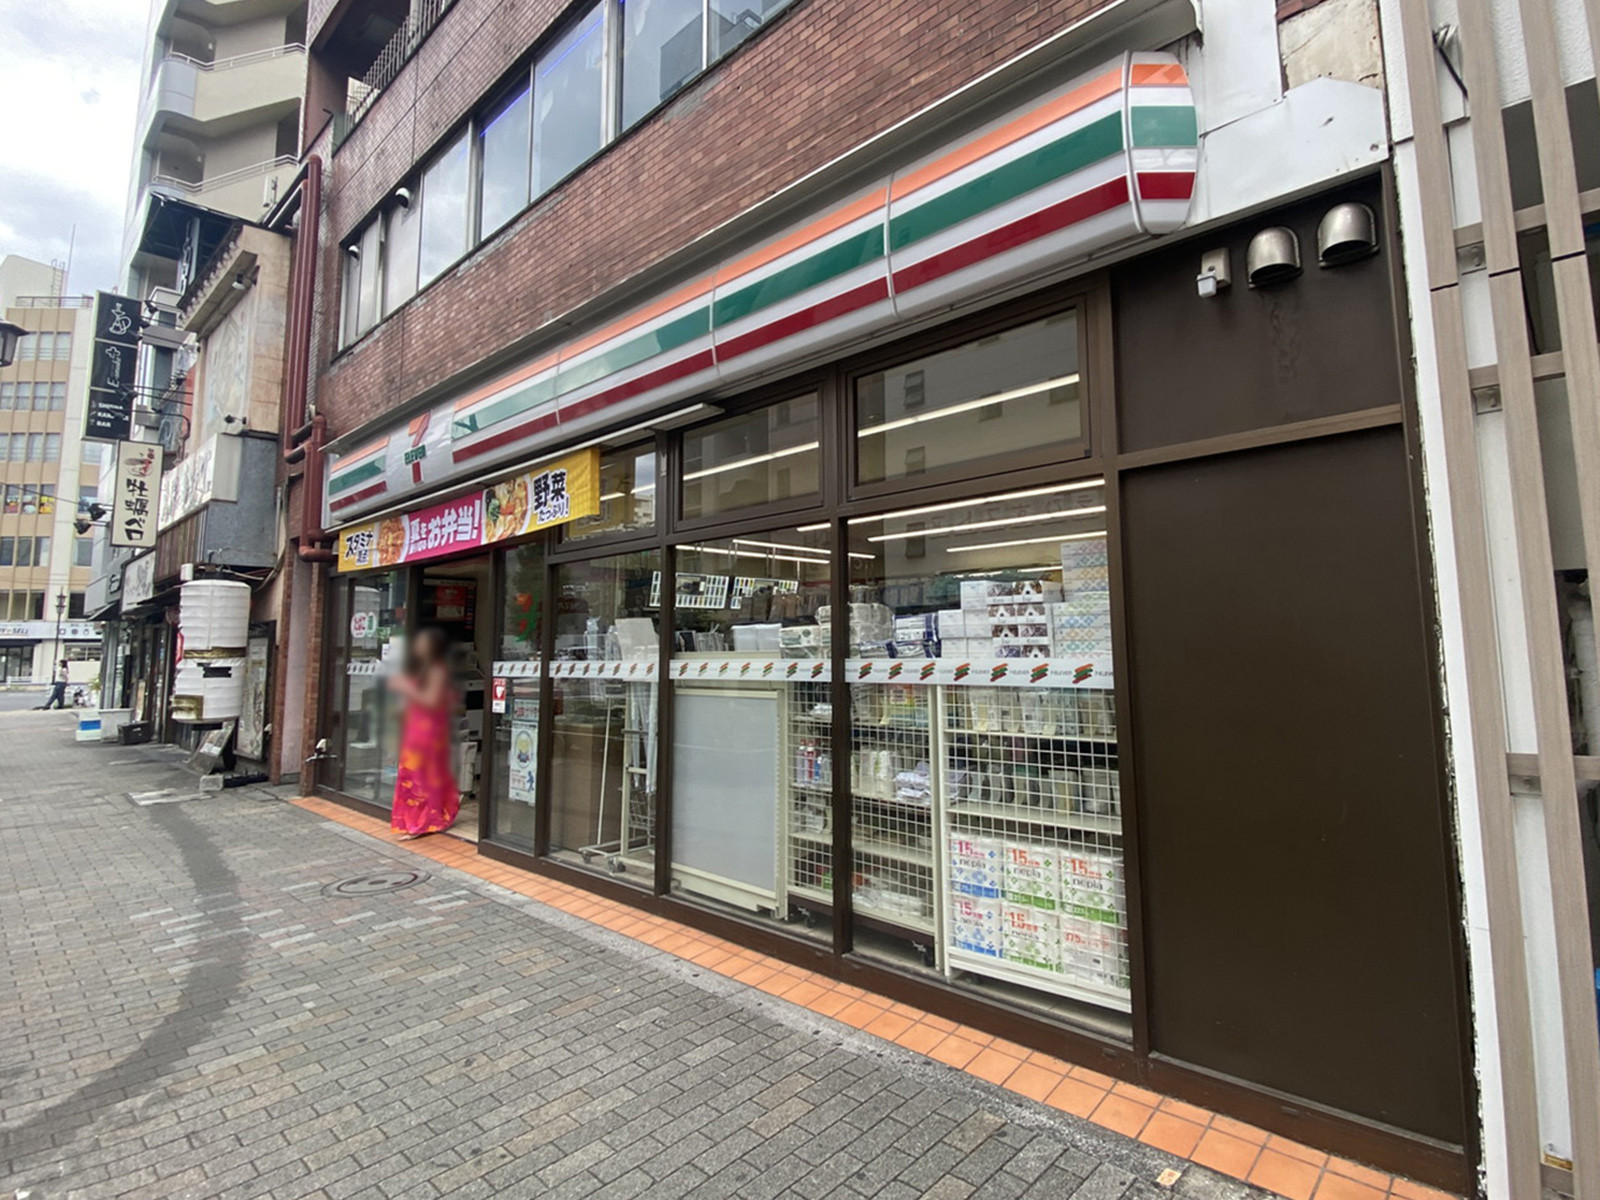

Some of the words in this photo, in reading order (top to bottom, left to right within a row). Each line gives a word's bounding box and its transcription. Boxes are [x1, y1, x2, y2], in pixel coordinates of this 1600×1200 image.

[96, 420, 112, 428] BAR
[534, 470, 566, 511] 野菜
[427, 498, 481, 550] お弁当!
[345, 529, 374, 559] スタミナ
